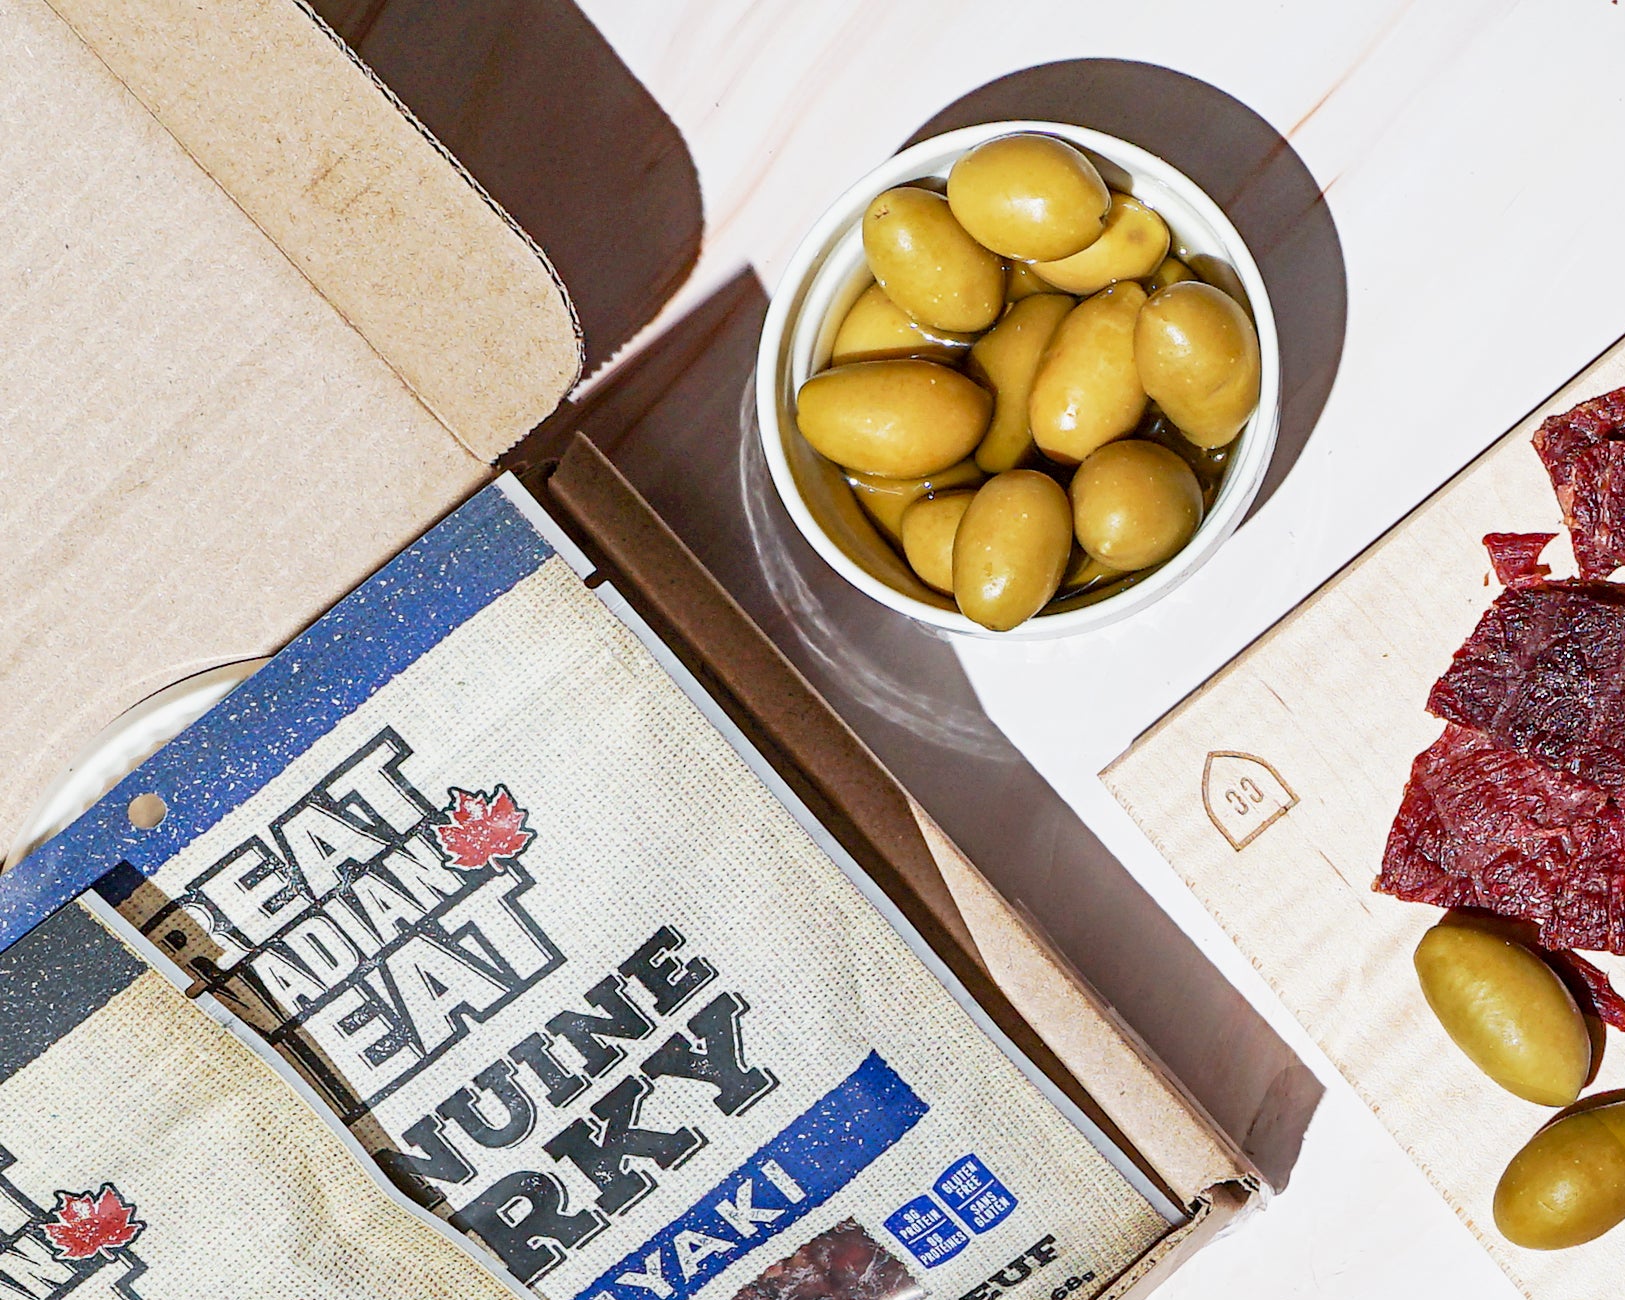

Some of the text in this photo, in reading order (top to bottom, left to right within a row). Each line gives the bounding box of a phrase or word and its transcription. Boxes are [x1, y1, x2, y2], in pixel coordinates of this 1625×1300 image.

[273, 858, 581, 1131] EAT
[940, 1159, 978, 1195] GLUTEN
[955, 1174, 982, 1200] FREE
[969, 1190, 997, 1216] SANS
[973, 1195, 1010, 1228] GLUTEN
[899, 1207, 941, 1240] PROTEIN
